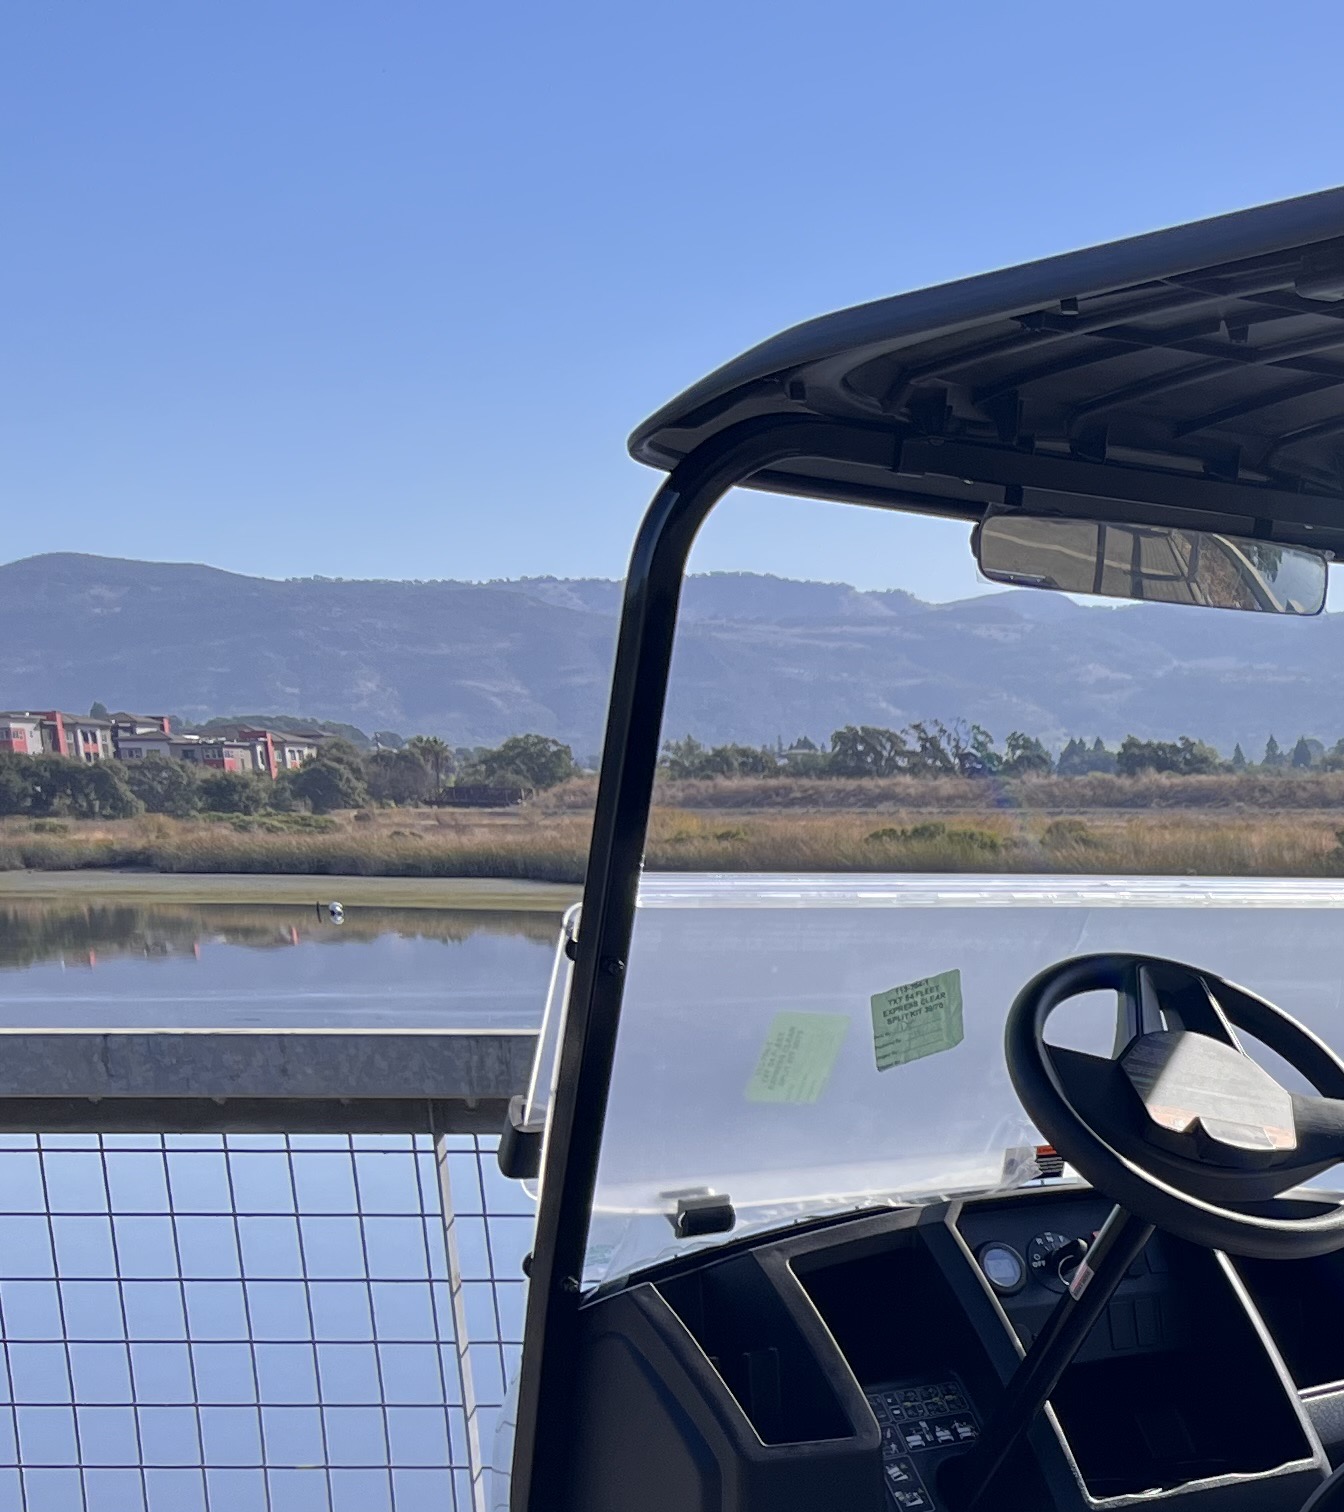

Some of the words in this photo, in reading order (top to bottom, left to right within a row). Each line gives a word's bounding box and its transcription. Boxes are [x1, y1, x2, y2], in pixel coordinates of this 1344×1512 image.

[882, 1000, 918, 1018] EXPRESS
[920, 991, 946, 1006] CLEAR
[886, 1013, 909, 1026] SPLIT
[910, 1007, 922, 1018] KIT
